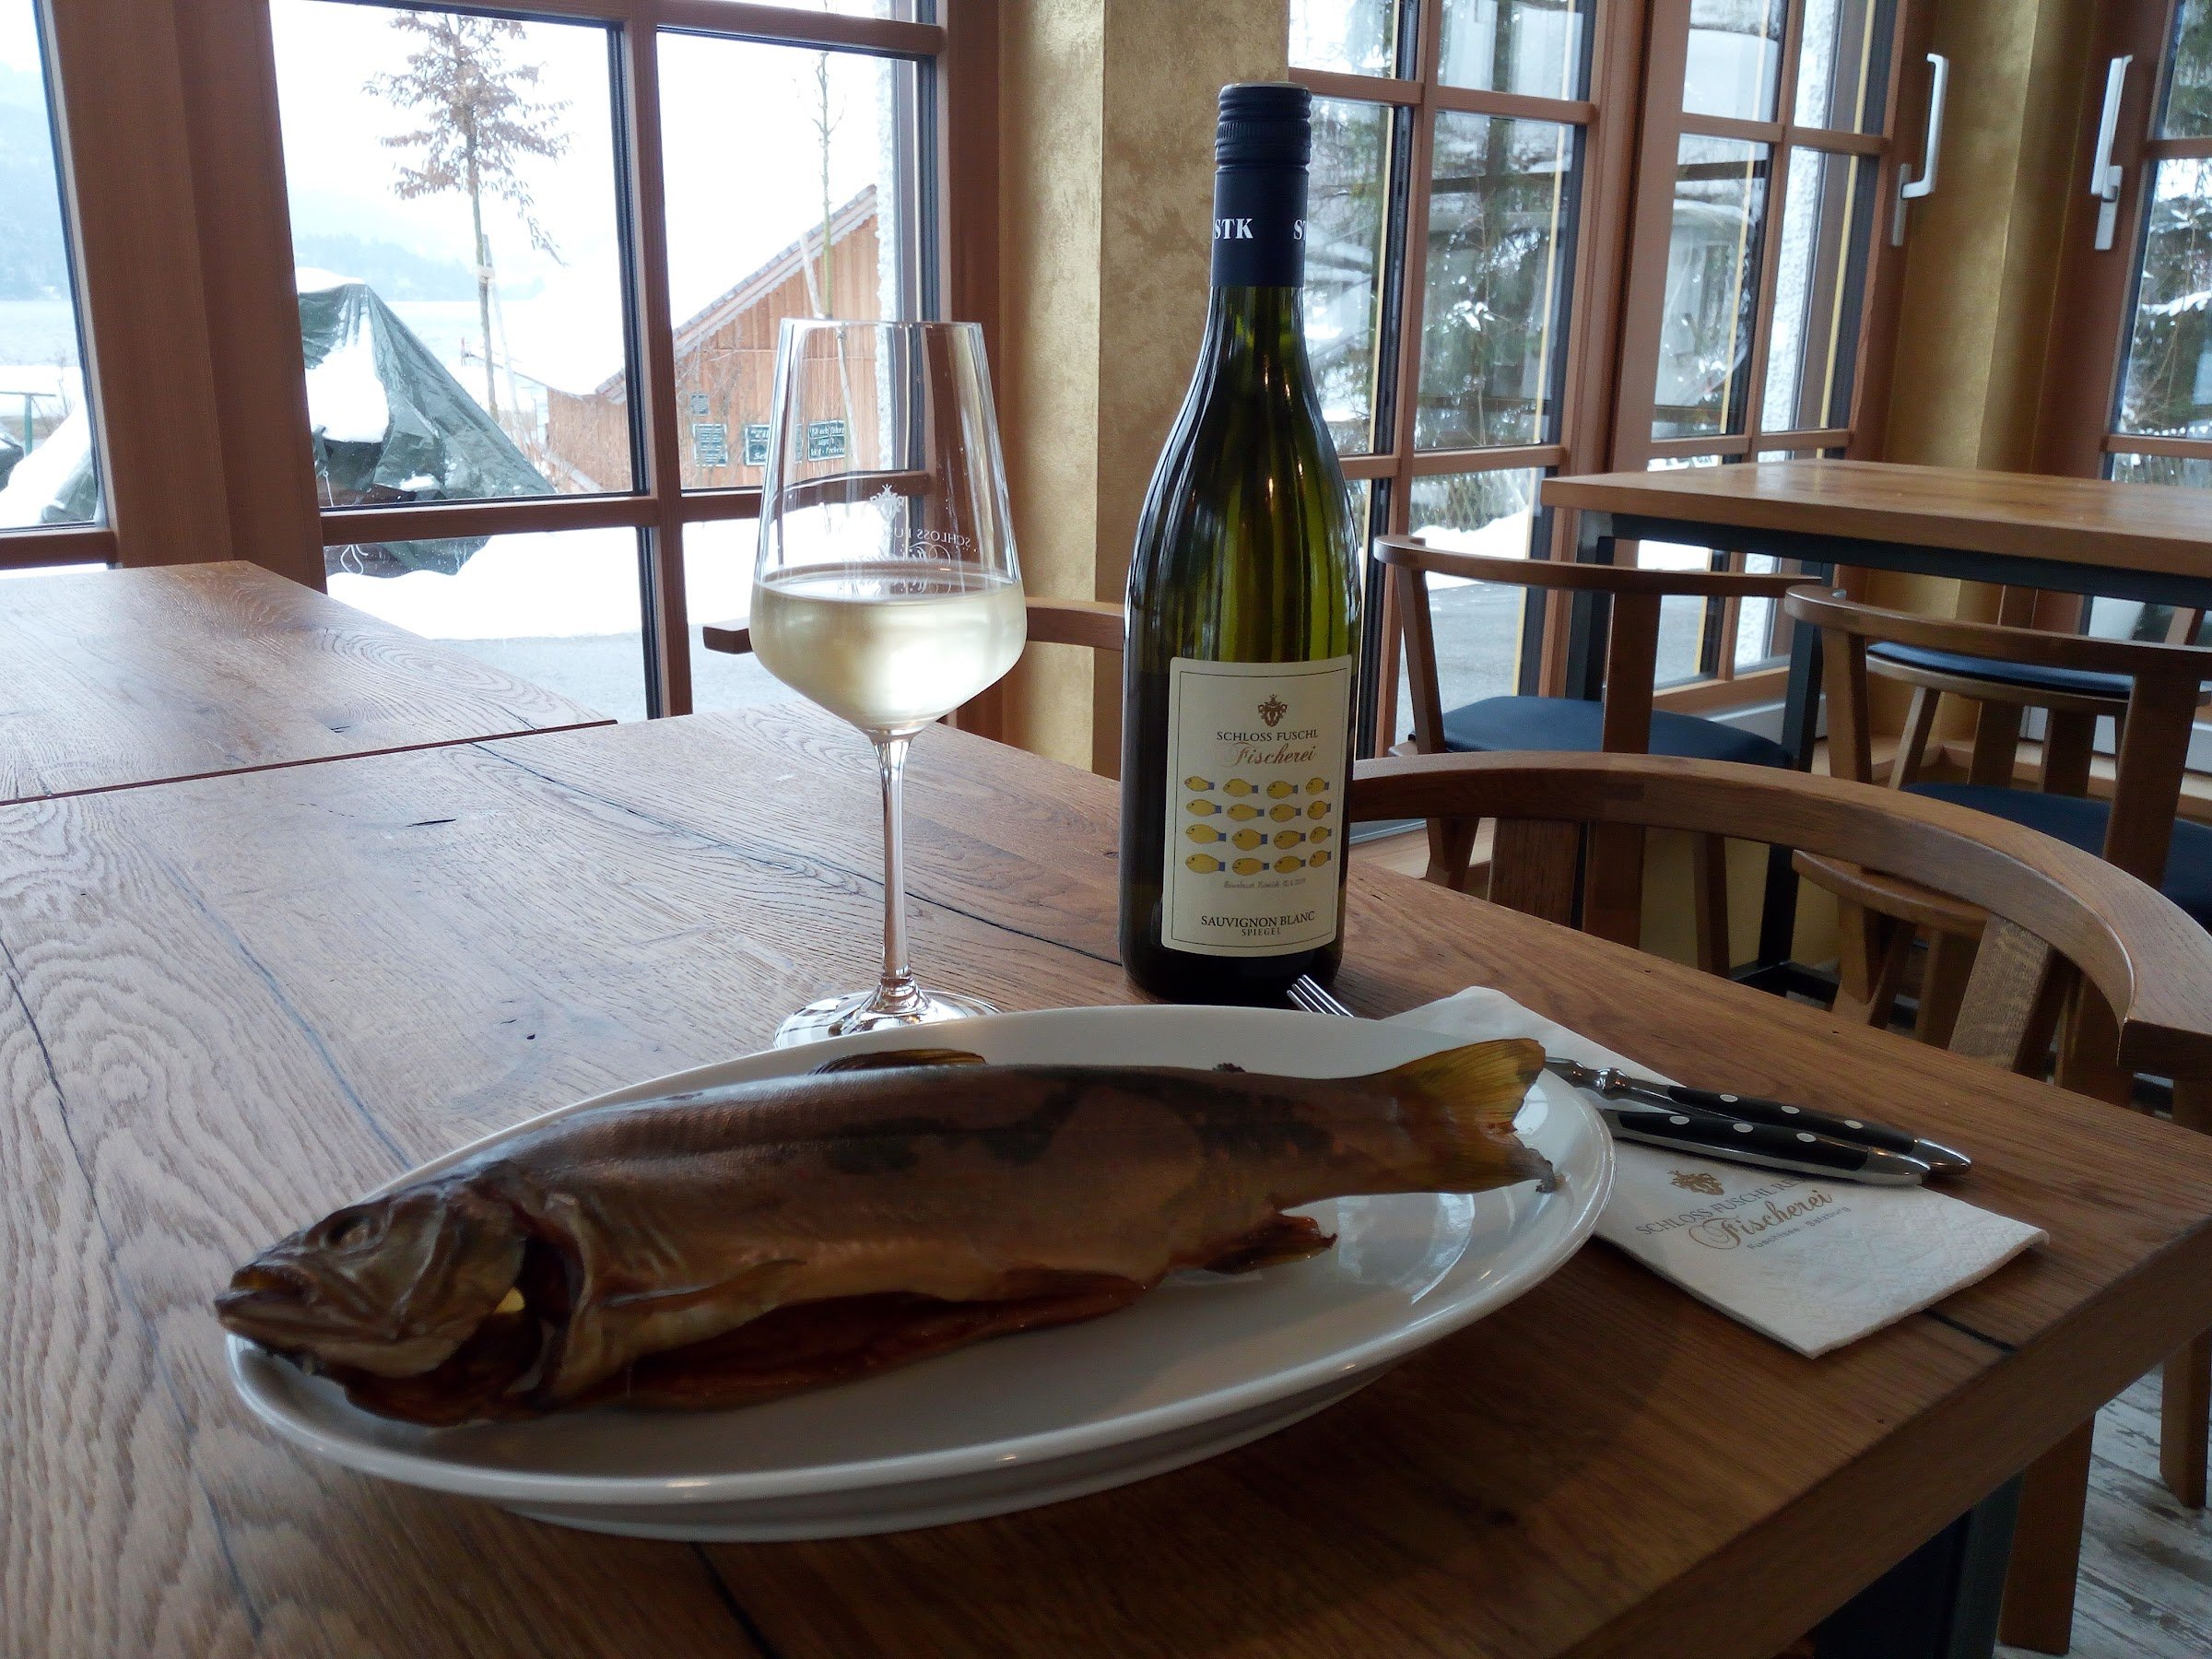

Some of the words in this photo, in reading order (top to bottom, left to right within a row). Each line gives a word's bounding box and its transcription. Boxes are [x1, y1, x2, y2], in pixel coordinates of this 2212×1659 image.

[1214, 218, 1253, 240] STK
[1216, 731, 1273, 742] SCHLOSS
[1277, 729, 1319, 742] FUSCHL
[1226, 741, 1317, 767] Fischerei
[1201, 915, 1277, 929] SAUVIGNON
[1280, 911, 1316, 926] BLANC
[1241, 927, 1281, 936] SPIEGEL
[1635, 1207, 1713, 1235] SCHLOSS
[1712, 1187, 1778, 1214] FUSCHL
[1688, 1189, 1833, 1250] Fischerei
